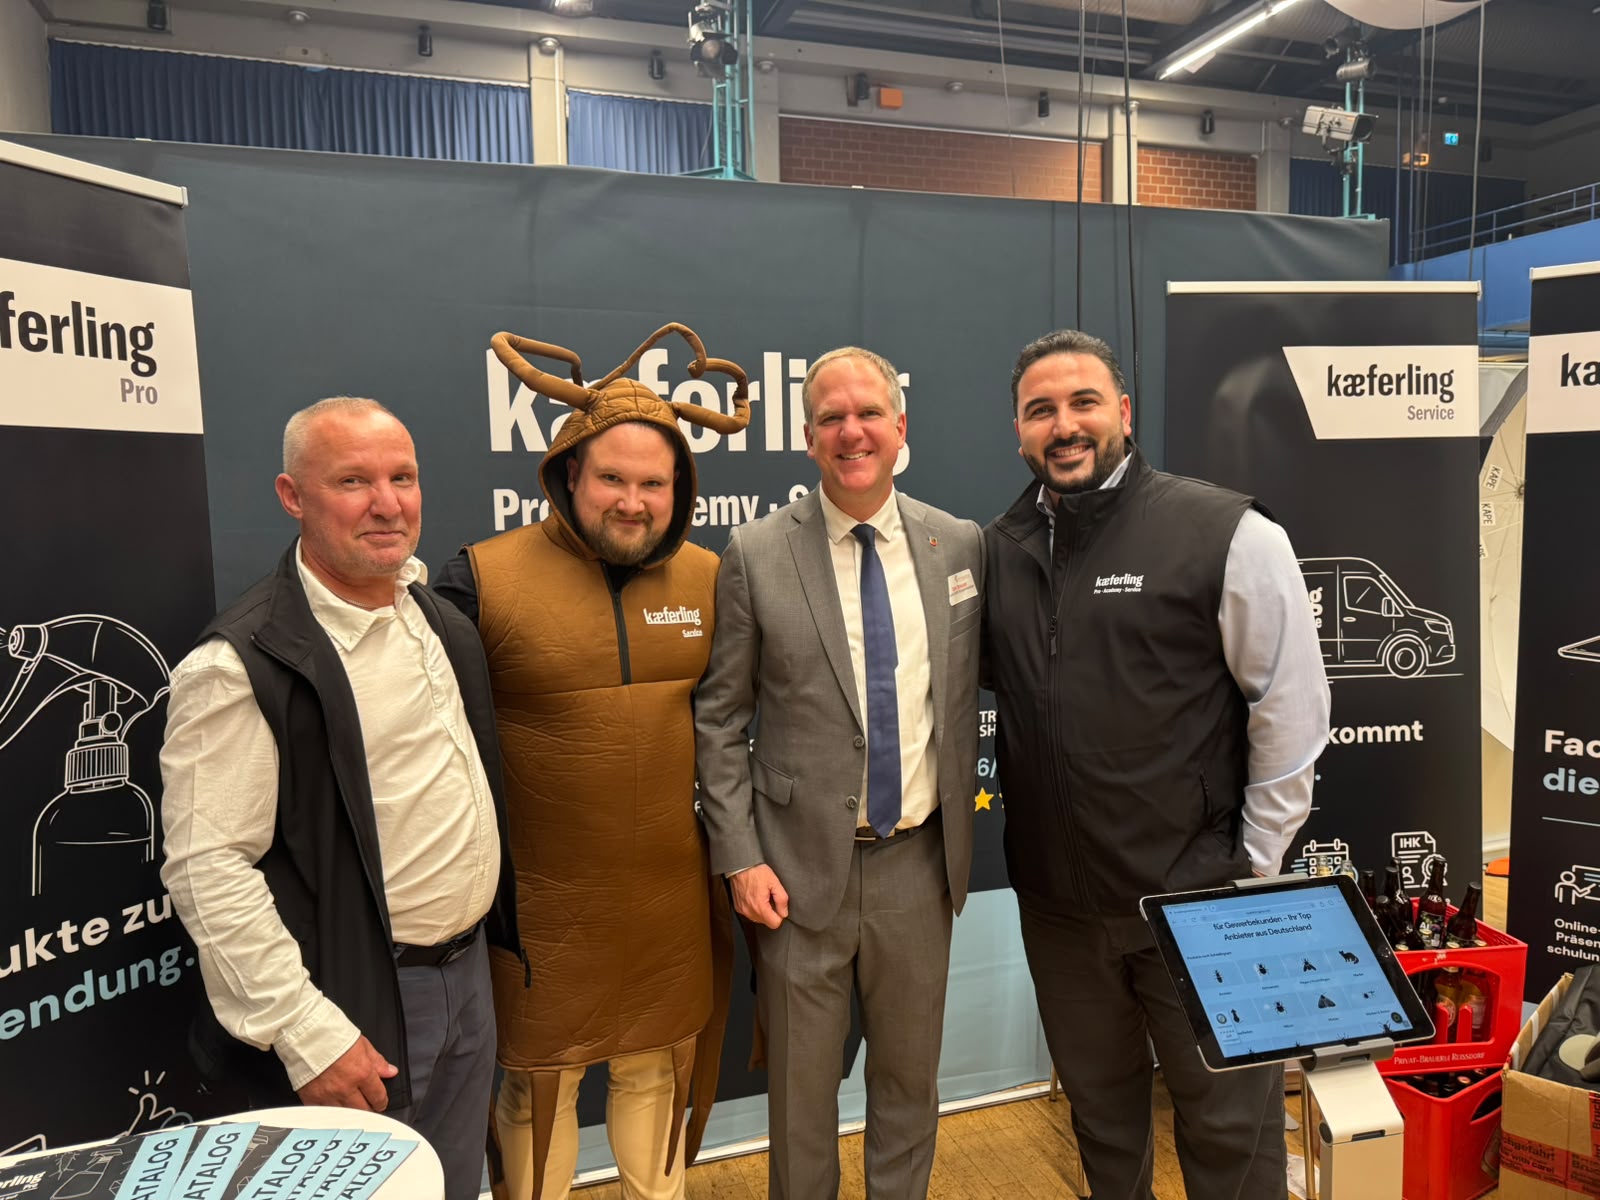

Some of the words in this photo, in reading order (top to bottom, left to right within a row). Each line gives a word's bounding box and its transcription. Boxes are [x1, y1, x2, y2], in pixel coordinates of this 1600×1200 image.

[120, 378, 158, 405] Pro
[1327, 363, 1454, 404] kæferling
[1407, 405, 1454, 420] Service
[1486, 466, 1501, 489] KAPE
[1481, 503, 1493, 525] KAPE
[1095, 573, 1144, 588] kæferling
[643, 606, 702, 626] kæferling
[1543, 767, 1600, 795] die
[1400, 838, 1421, 848] IHK
[122, 894, 180, 934] zu
[1224, 917, 1282, 929] Gewerbekunden
[1299, 912, 1311, 920] Top
[1224, 931, 1254, 941] Anbieter
[1268, 924, 1312, 936] Deutschland
